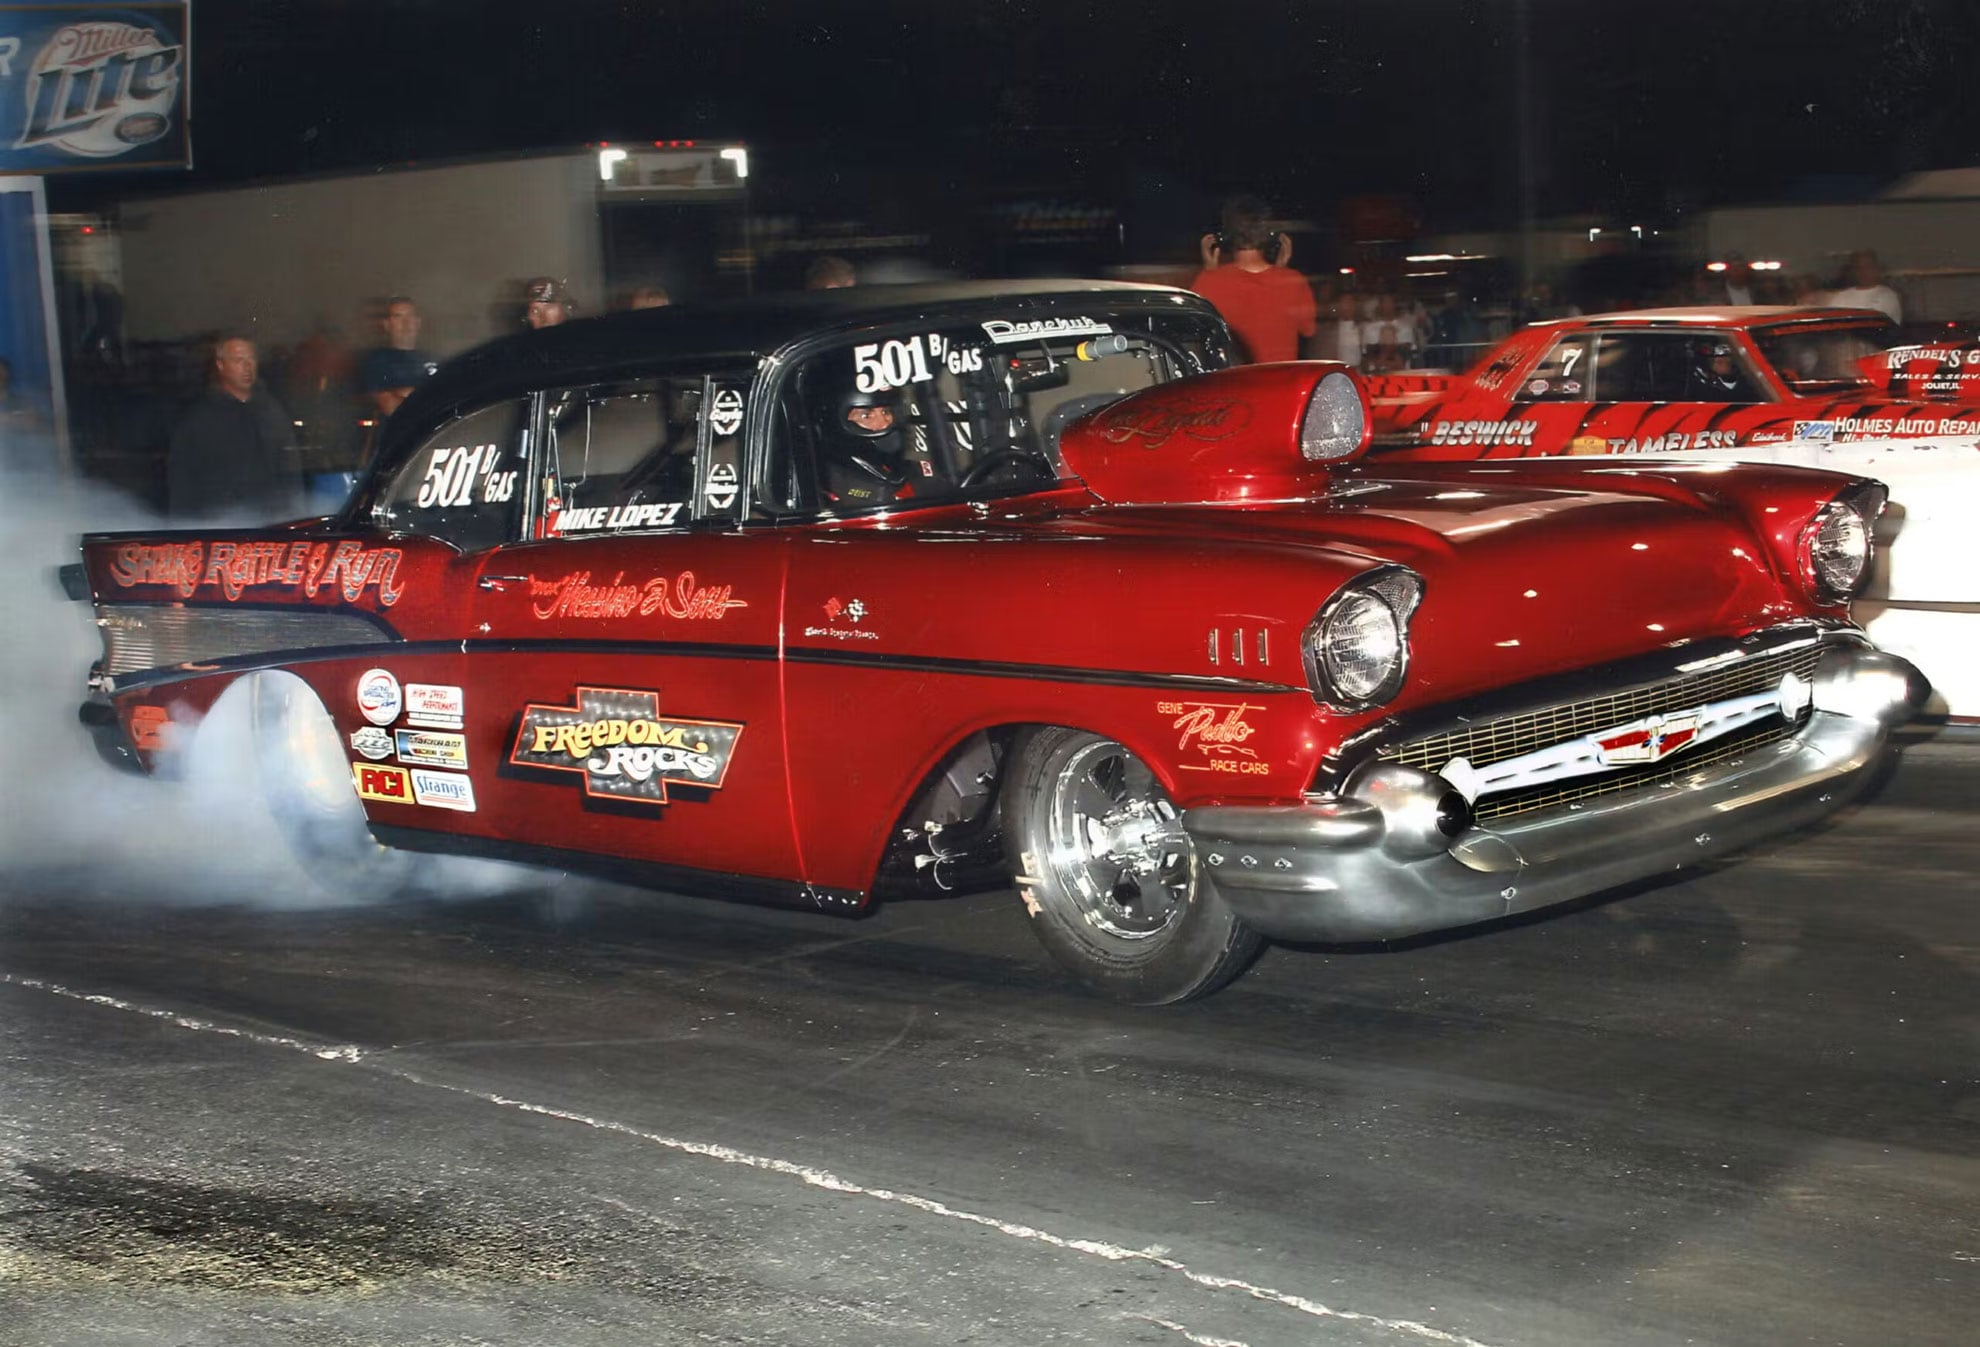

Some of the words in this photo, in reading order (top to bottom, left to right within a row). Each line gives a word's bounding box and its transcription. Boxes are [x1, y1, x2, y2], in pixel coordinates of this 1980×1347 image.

[59, 27, 156, 59] Miller
[12, 44, 183, 150] Lite
[854, 336, 933, 393] 501
[1561, 348, 1583, 377] 7
[1886, 349, 1962, 369] RENDEL'S
[1432, 420, 1537, 446] BESWICK
[1834, 416, 1893, 433] HOLMES
[1895, 418, 1930, 434] AUTO
[418, 445, 484, 508] 501
[553, 507, 608, 531] MIKE
[606, 503, 683, 528] LOPEZ
[1157, 701, 1183, 714] GENE
[1210, 759, 1237, 773] RACE
[1240, 762, 1269, 775] CARS
[361, 768, 405, 797] RCI
[416, 775, 466, 799] Strange
